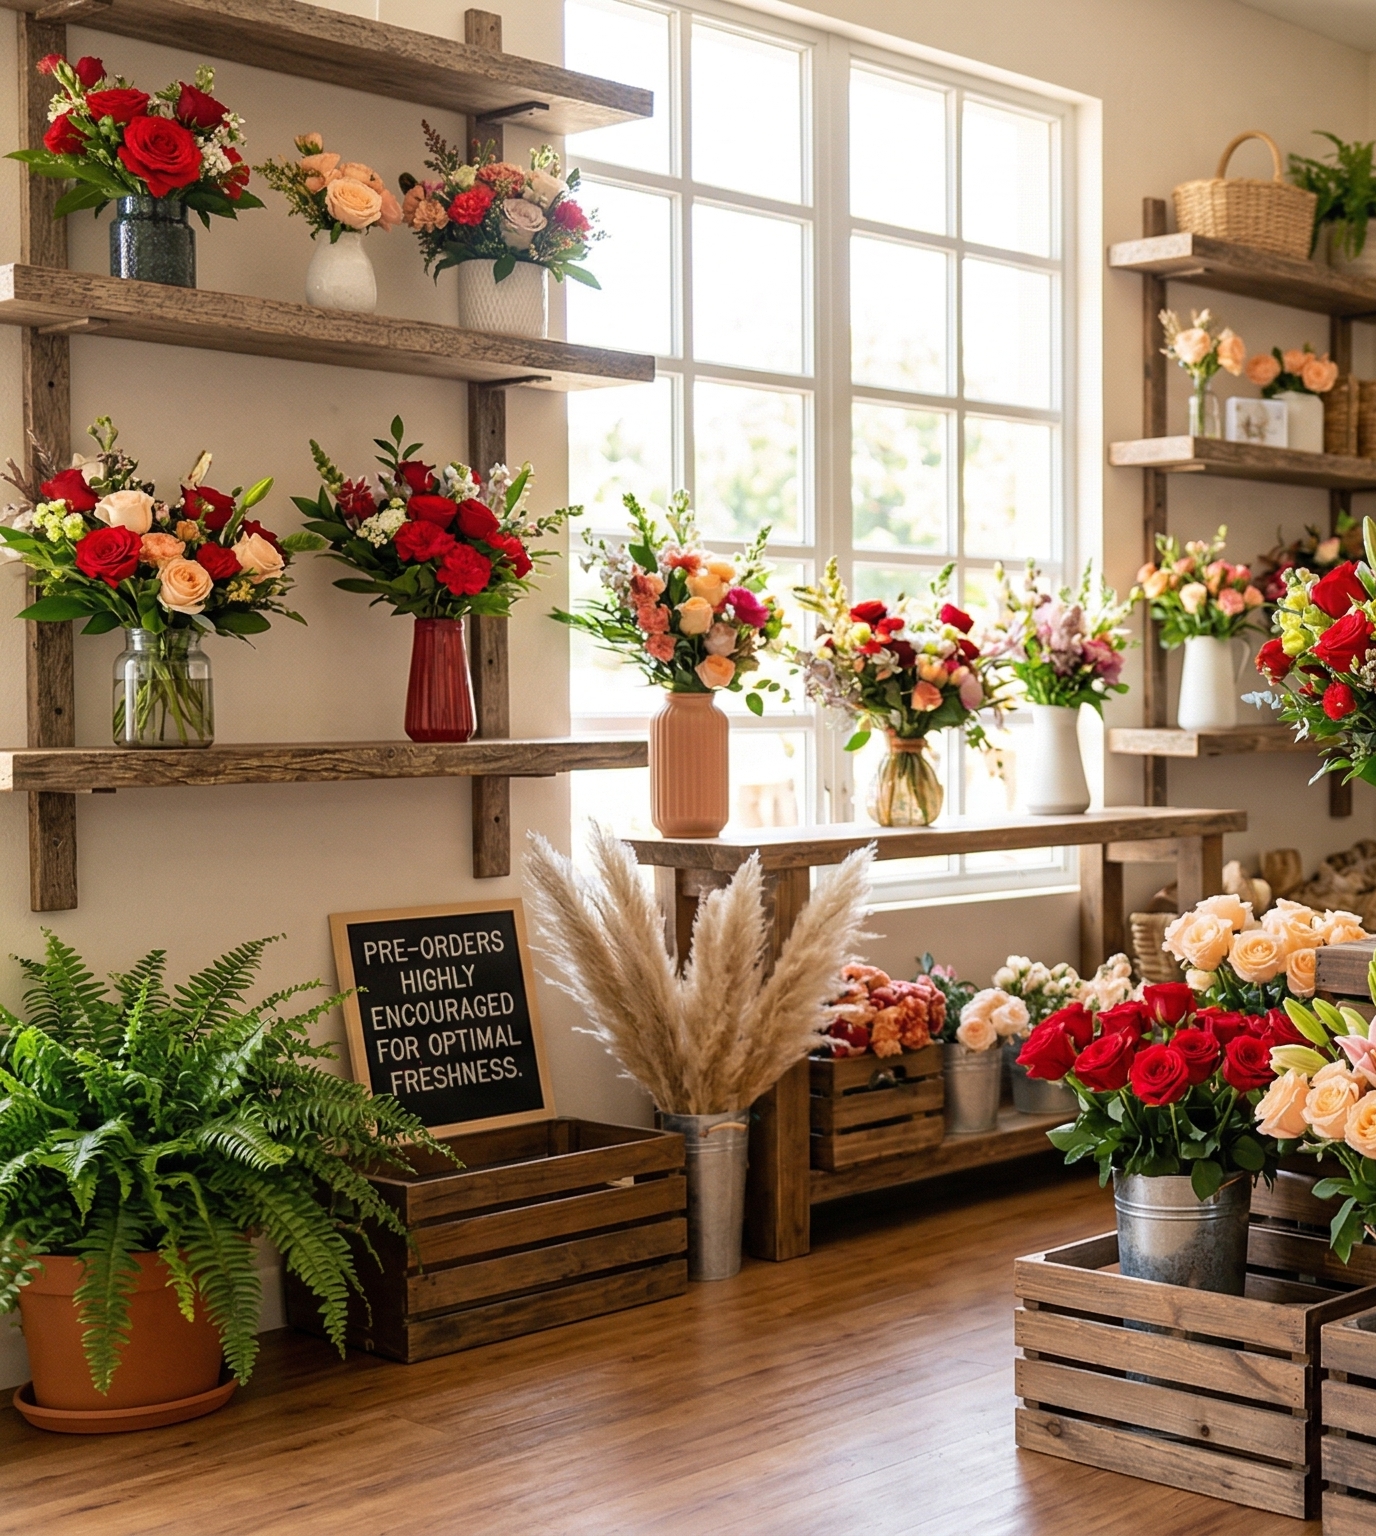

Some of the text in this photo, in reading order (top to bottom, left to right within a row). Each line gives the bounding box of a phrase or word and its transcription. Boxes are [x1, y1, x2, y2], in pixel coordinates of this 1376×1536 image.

[363, 930, 504, 965] PRE-ORDERS
[400, 964, 474, 994] HIGHLY
[370, 992, 514, 1030] ENCOURAGED
[376, 1024, 521, 1063] FOR OPTIMAL
[390, 1056, 522, 1095] FRESHNESS.
